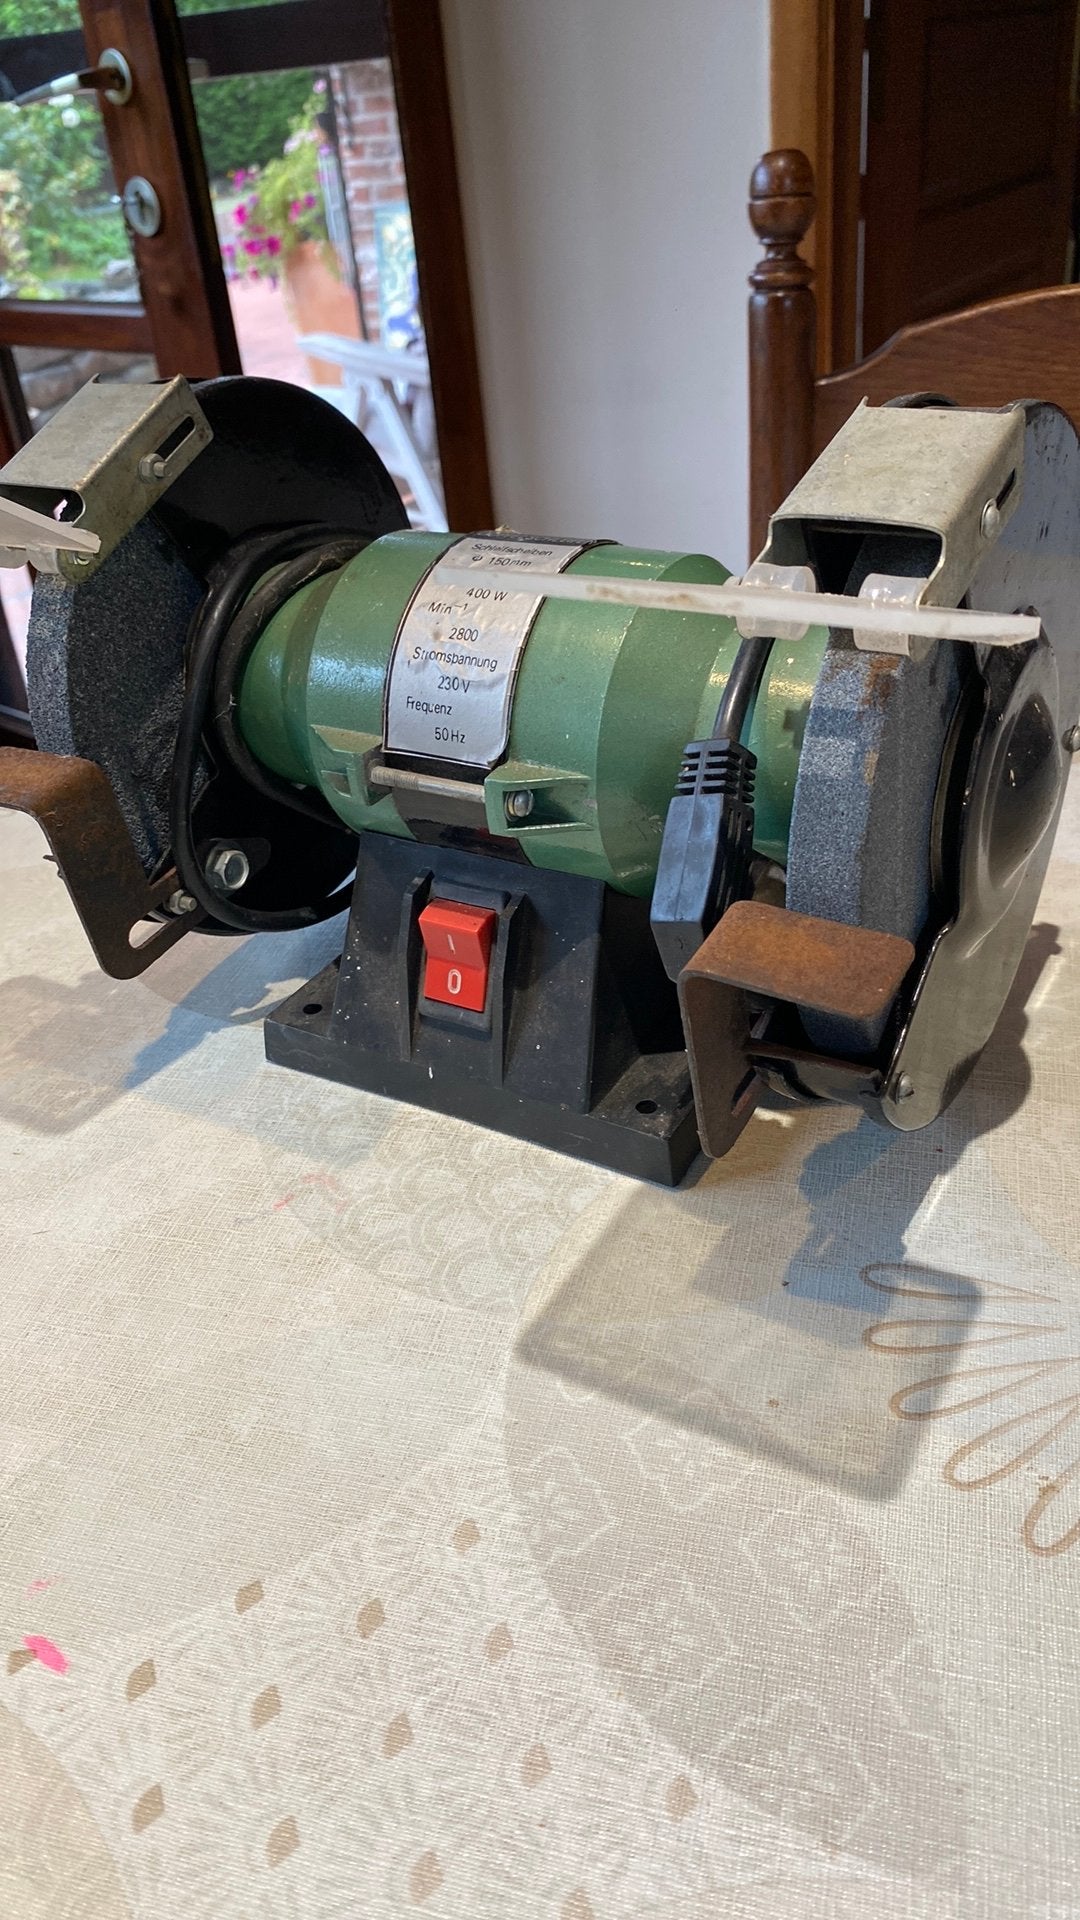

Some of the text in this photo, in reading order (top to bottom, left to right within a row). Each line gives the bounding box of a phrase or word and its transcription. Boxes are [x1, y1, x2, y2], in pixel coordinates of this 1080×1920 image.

[466, 587, 509, 602] 400 W
[448, 627, 479, 642] 2800
[412, 646, 498, 672] Stromspannung
[437, 675, 471, 693] 230 V
[406, 696, 453, 716] Frequenz
[434, 727, 466, 744] 50 Hz
